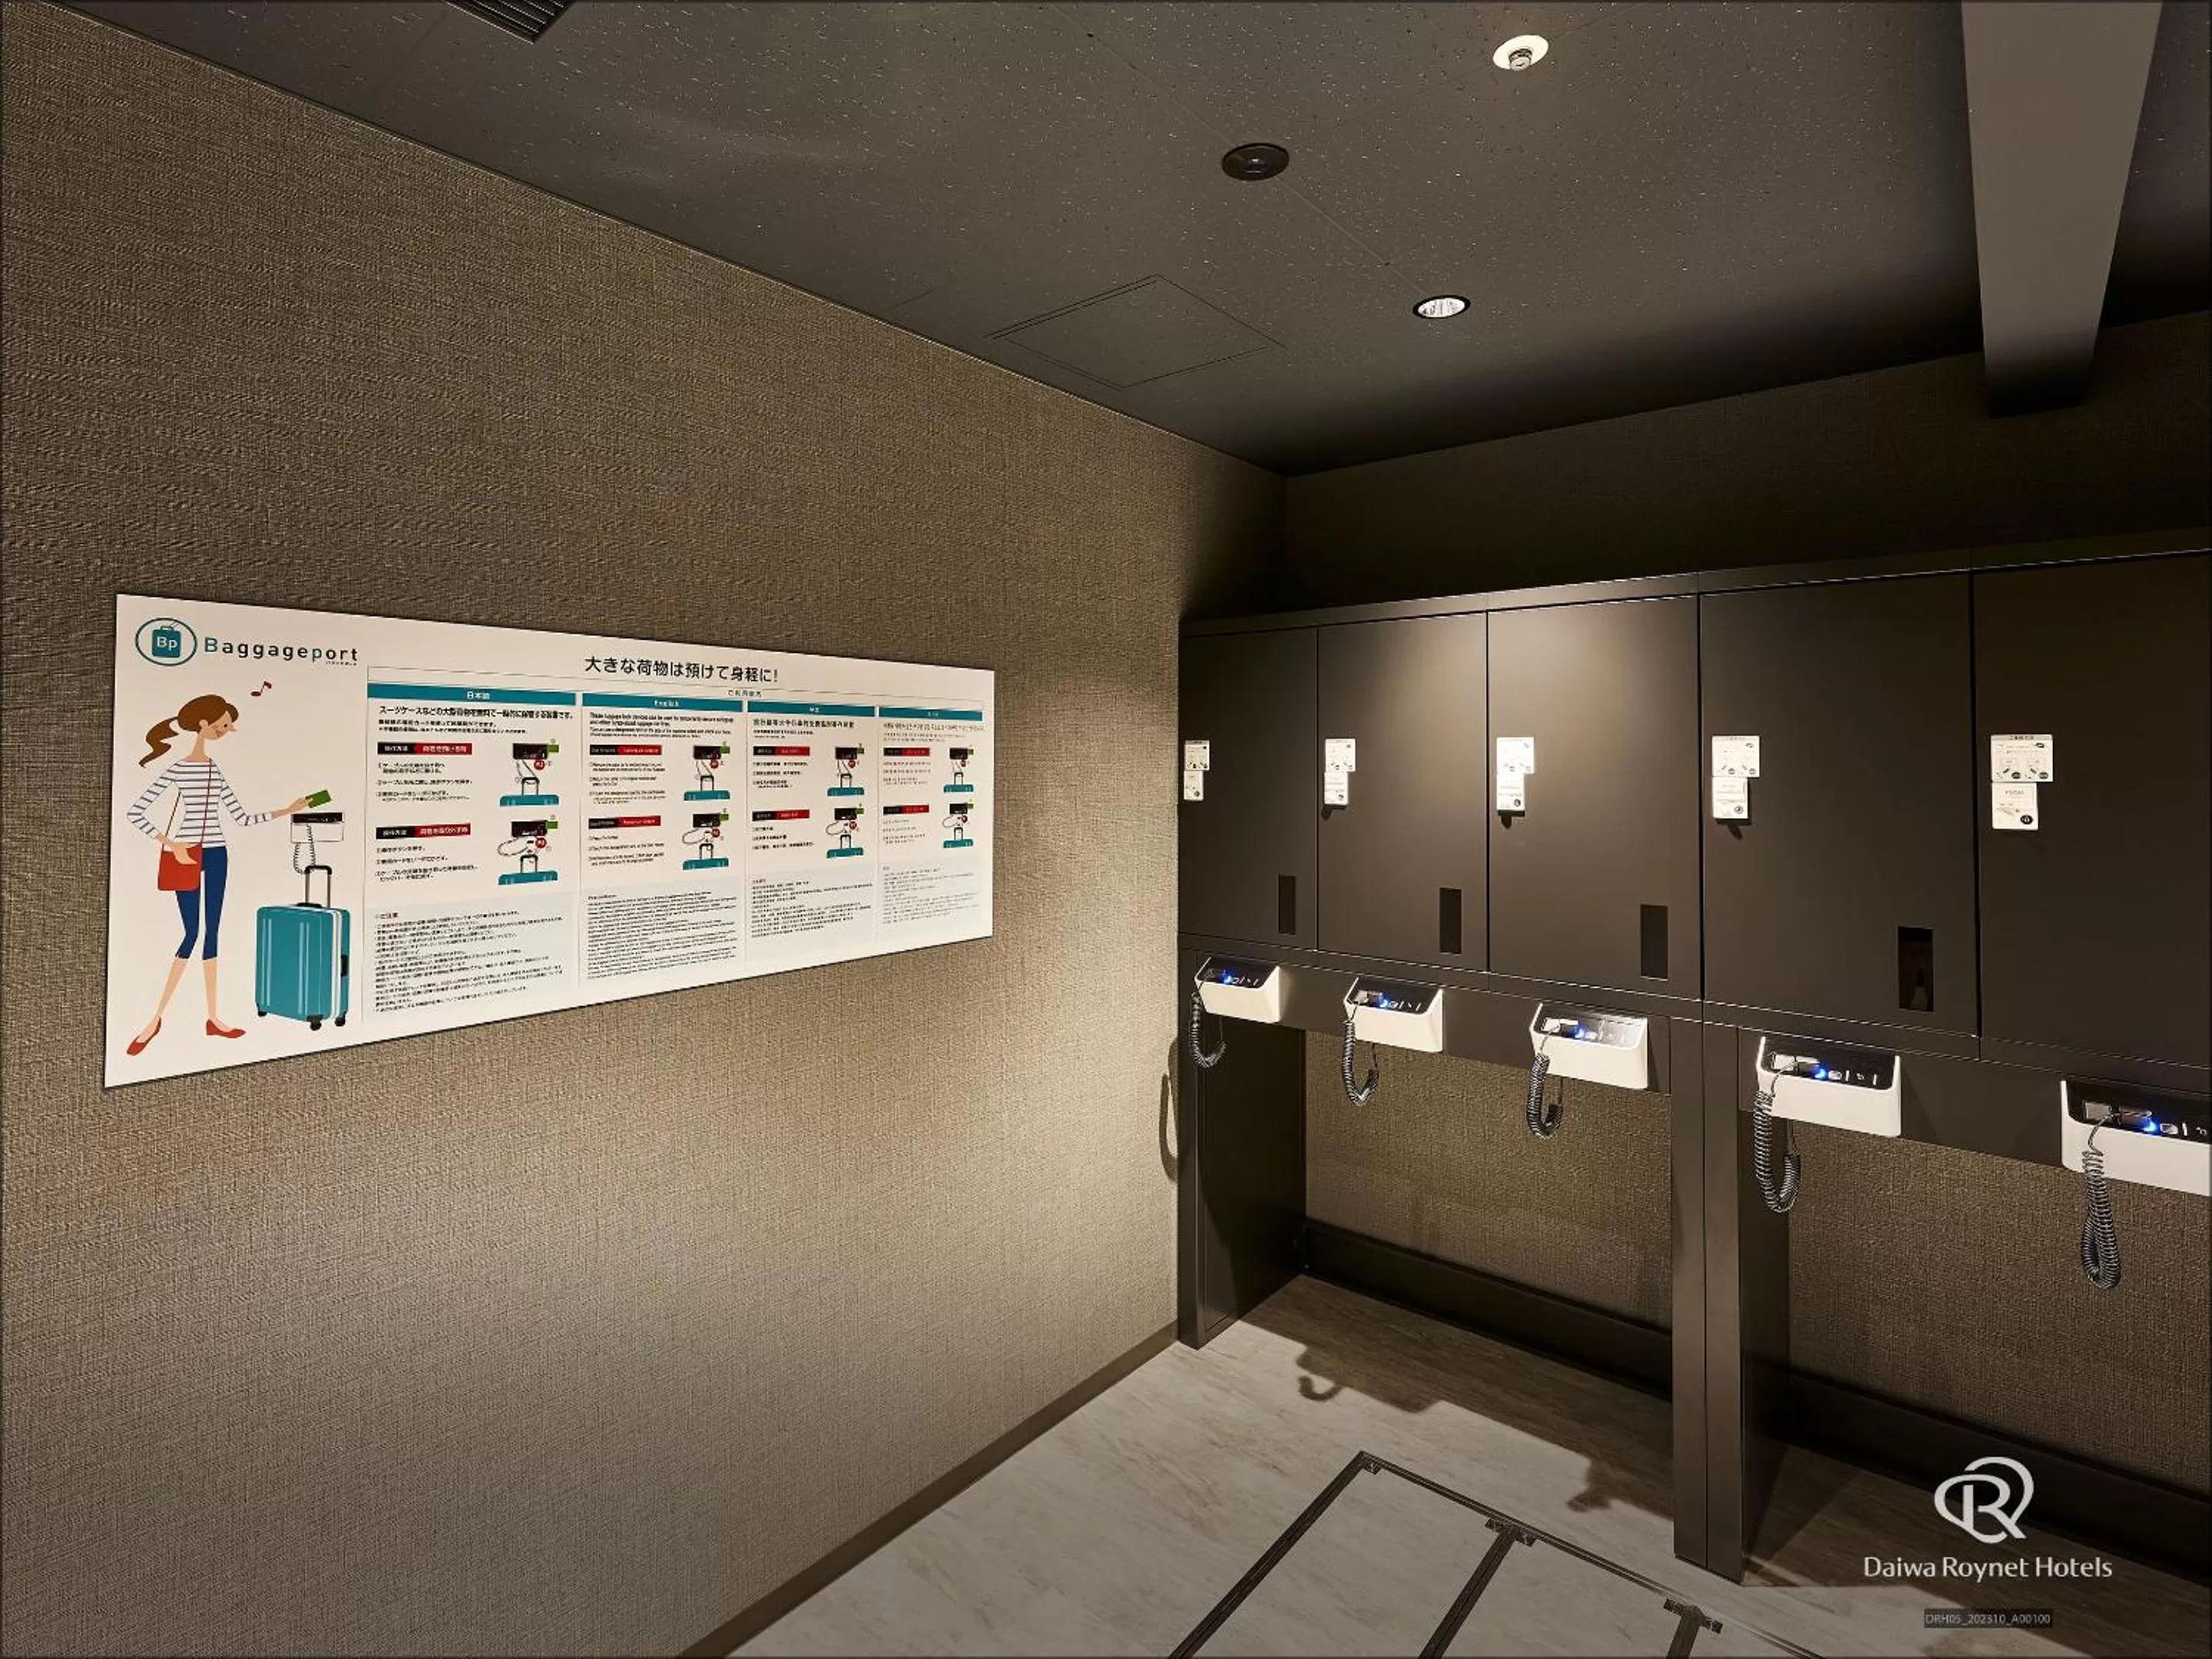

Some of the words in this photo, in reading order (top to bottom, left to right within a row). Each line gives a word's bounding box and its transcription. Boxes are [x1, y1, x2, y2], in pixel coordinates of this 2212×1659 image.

[156, 636, 178, 651] Bp
[204, 637, 358, 662] Baggageport
[584, 656, 778, 682] 大きな荷物は預けて身軽に!
